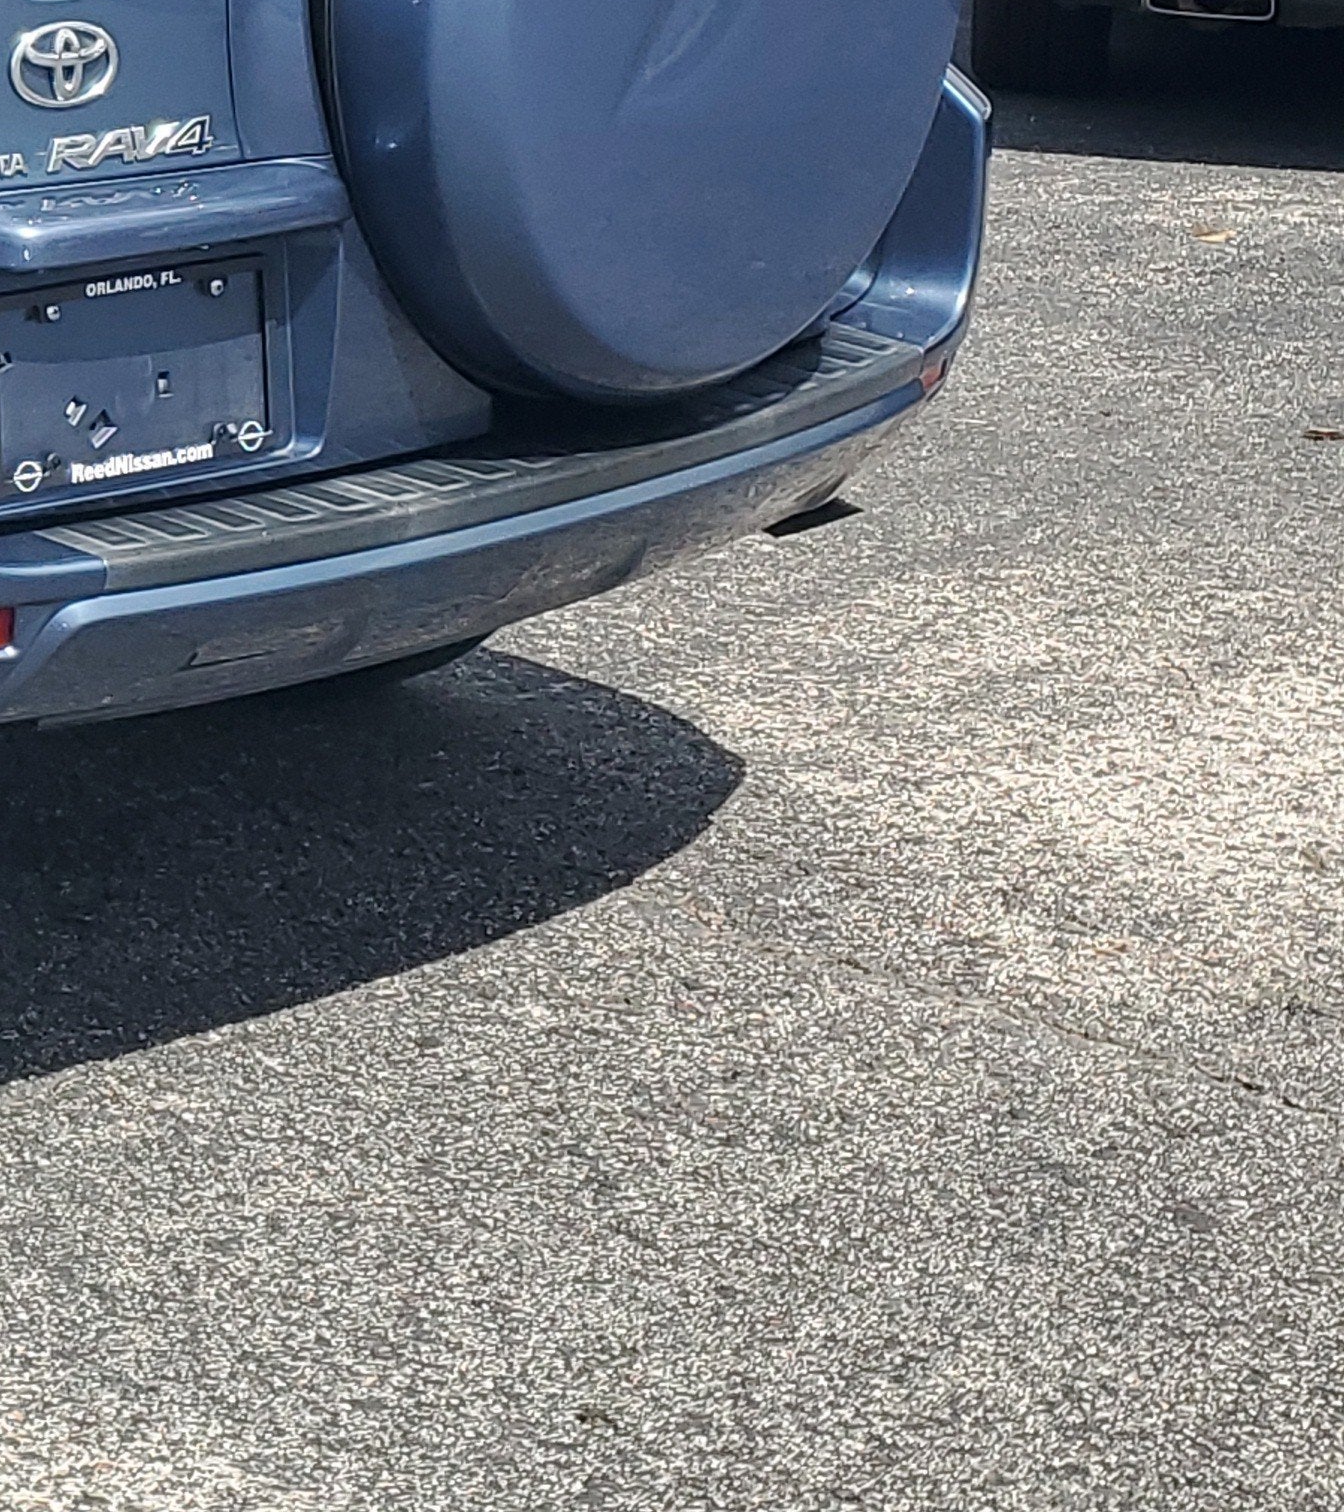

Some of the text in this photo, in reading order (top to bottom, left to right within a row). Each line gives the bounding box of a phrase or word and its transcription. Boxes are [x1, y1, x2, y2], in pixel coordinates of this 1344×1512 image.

[46, 115, 214, 175] RAV4
[85, 274, 158, 298] ORLANDO,
[70, 441, 215, 484] ReedNissan.com
